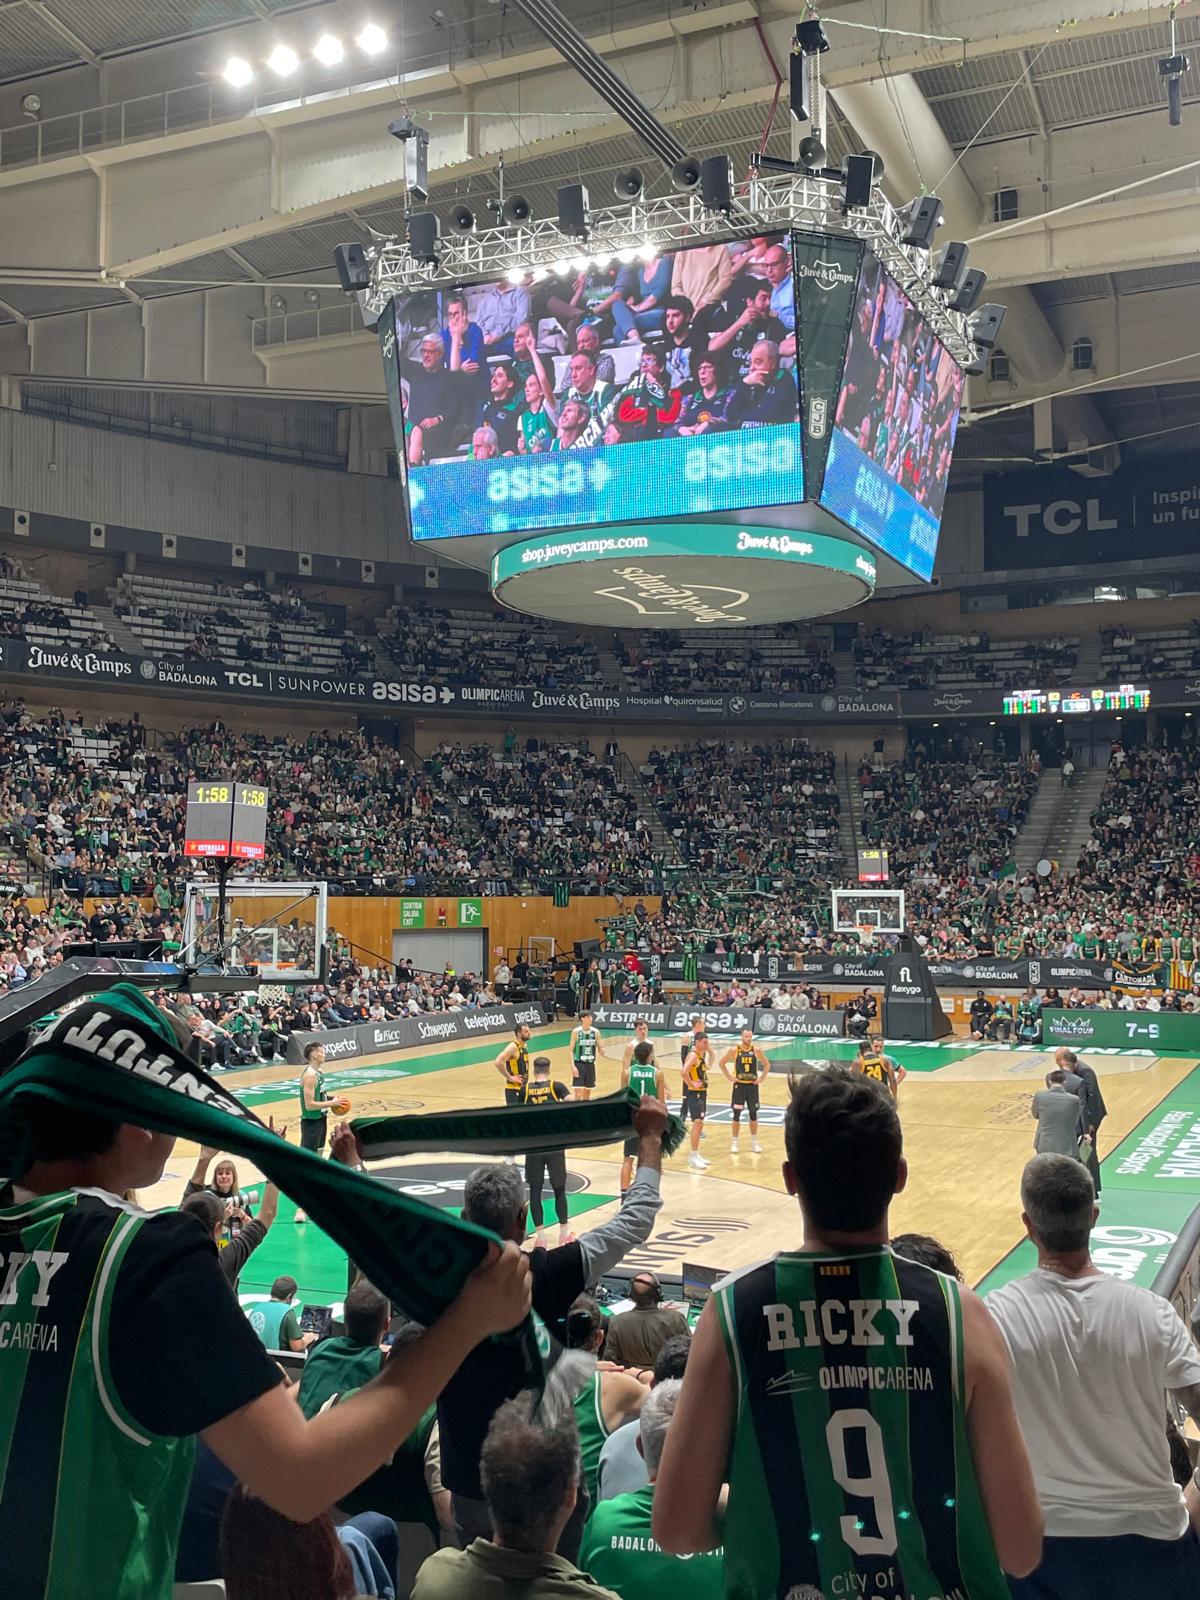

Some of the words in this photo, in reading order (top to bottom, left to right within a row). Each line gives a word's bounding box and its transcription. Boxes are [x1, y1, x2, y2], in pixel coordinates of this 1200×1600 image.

[488, 461, 584, 502] asisa
[1003, 498, 1118, 537] TCL
[1152, 511, 1175, 524] un
[522, 536, 648, 563] shop.juveycamps.com
[28, 646, 68, 668] Juvé
[70, 653, 83, 670] &
[85, 654, 132, 677] Camps
[158, 661, 174, 673] City
[175, 663, 185, 672] of
[158, 671, 218, 686] BADALONA
[224, 671, 264, 688] TCL
[278, 676, 366, 696] SUNPOWER
[372, 681, 437, 704] asisa
[461, 687, 525, 702] OLIMPICARENA
[532, 690, 568, 708] Juvé
[568, 694, 578, 709] &
[579, 692, 620, 709] Camps
[626, 696, 662, 706] Hospital
[838, 695, 853, 705] City
[855, 695, 863, 703] of
[838, 703, 894, 712] BADALONA
[197, 787, 229, 803] 1:58
[241, 789, 265, 807] 1:58
[844, 969, 884, 977] BADALONA
[976, 965, 988, 973] City
[891, 985, 921, 995] flexygo
[464, 1012, 506, 1031] telepizza
[609, 1007, 665, 1024] ESTRELLA
[674, 1011, 733, 1028] assa
[778, 1014, 797, 1024] City
[798, 1014, 806, 1022] of
[418, 1019, 457, 1039] Schweppes
[778, 1022, 839, 1034] BADALONA
[63, 1011, 246, 1117] ENTUT
[0, 1250, 69, 1306] KY
[762, 1299, 920, 1352] RICKY
[819, 1365, 934, 1392] OLIMPICARENA
[825, 1408, 899, 1557] 9
[611, 1535, 662, 1553] BADALON
[831, 1570, 867, 1593] City
[875, 1567, 895, 1589] of
